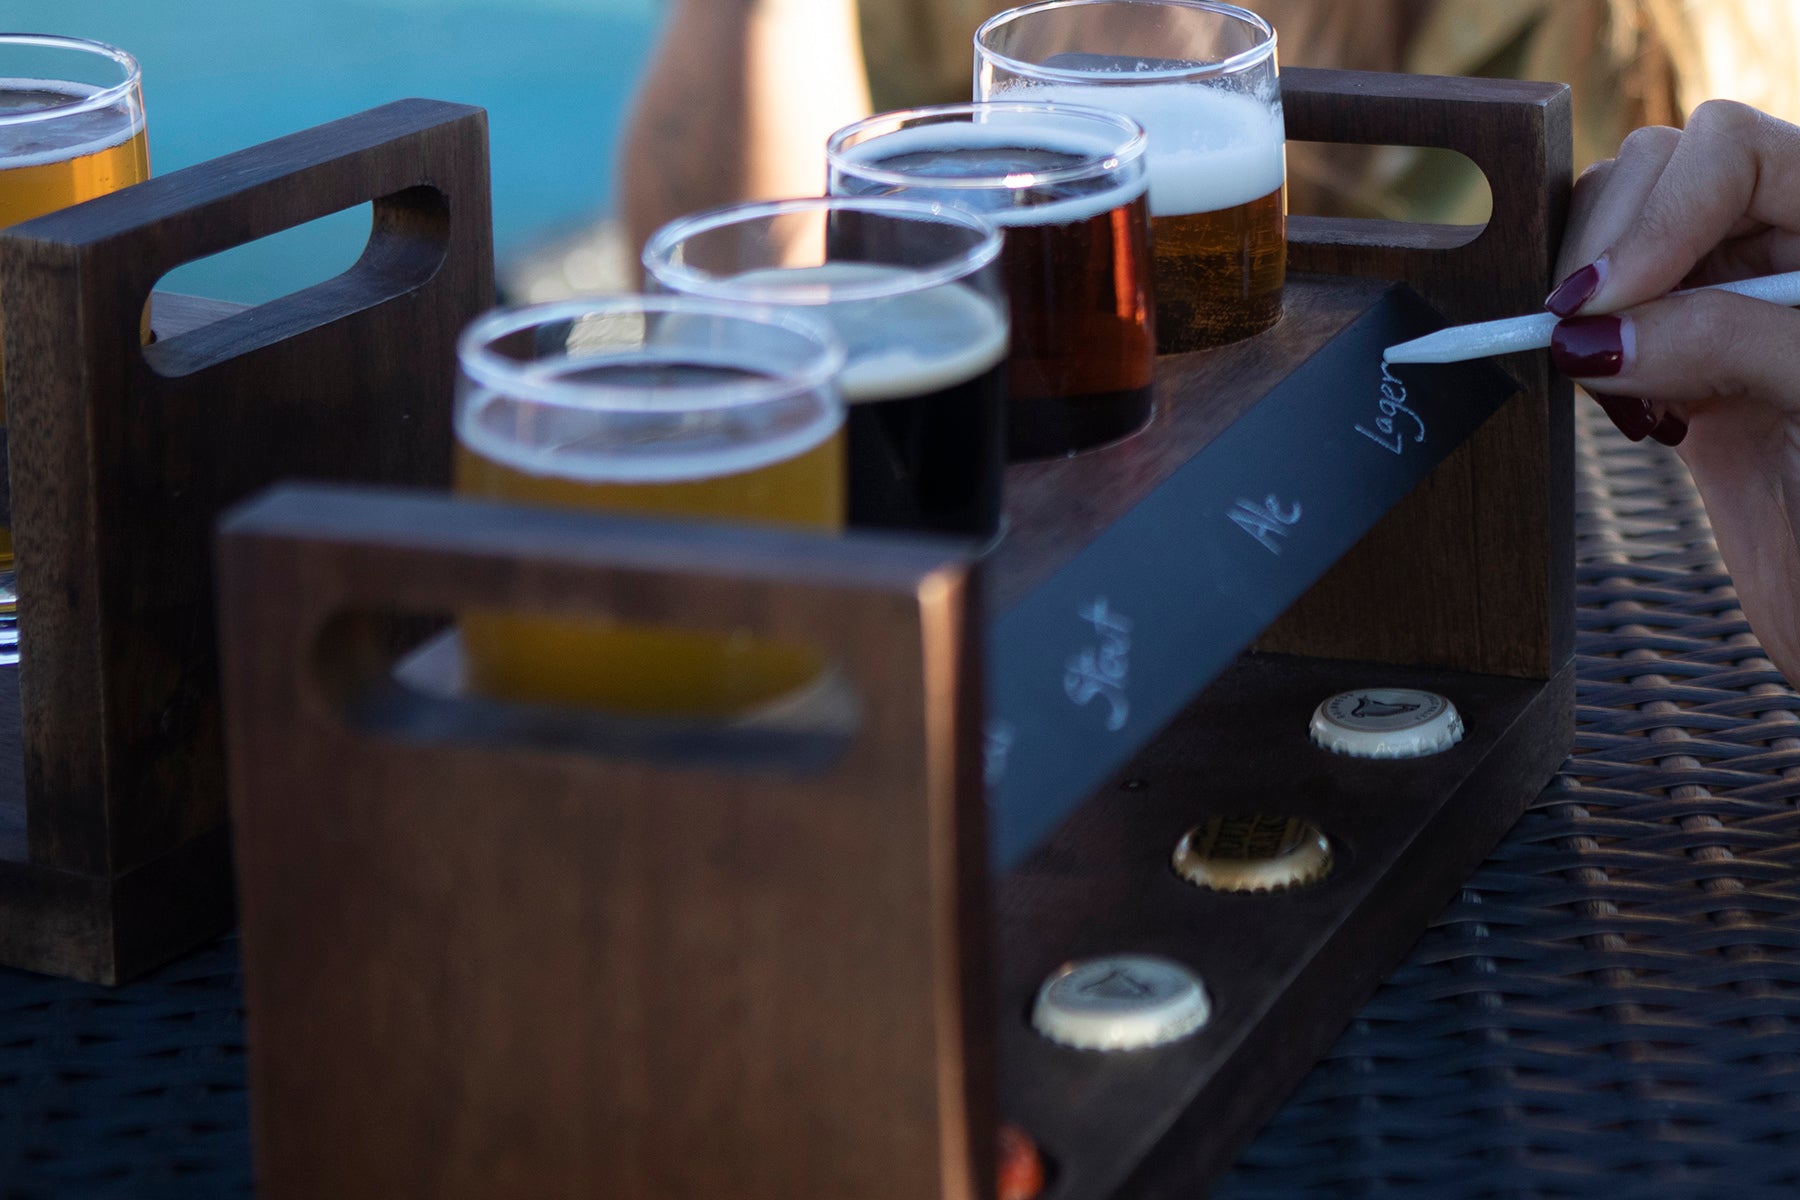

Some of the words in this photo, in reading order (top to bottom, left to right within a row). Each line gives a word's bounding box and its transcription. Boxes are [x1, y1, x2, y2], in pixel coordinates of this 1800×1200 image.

[1354, 361, 1425, 454] Lager
[1227, 494, 1302, 555] Ale
[1063, 597, 1132, 731] Stout
